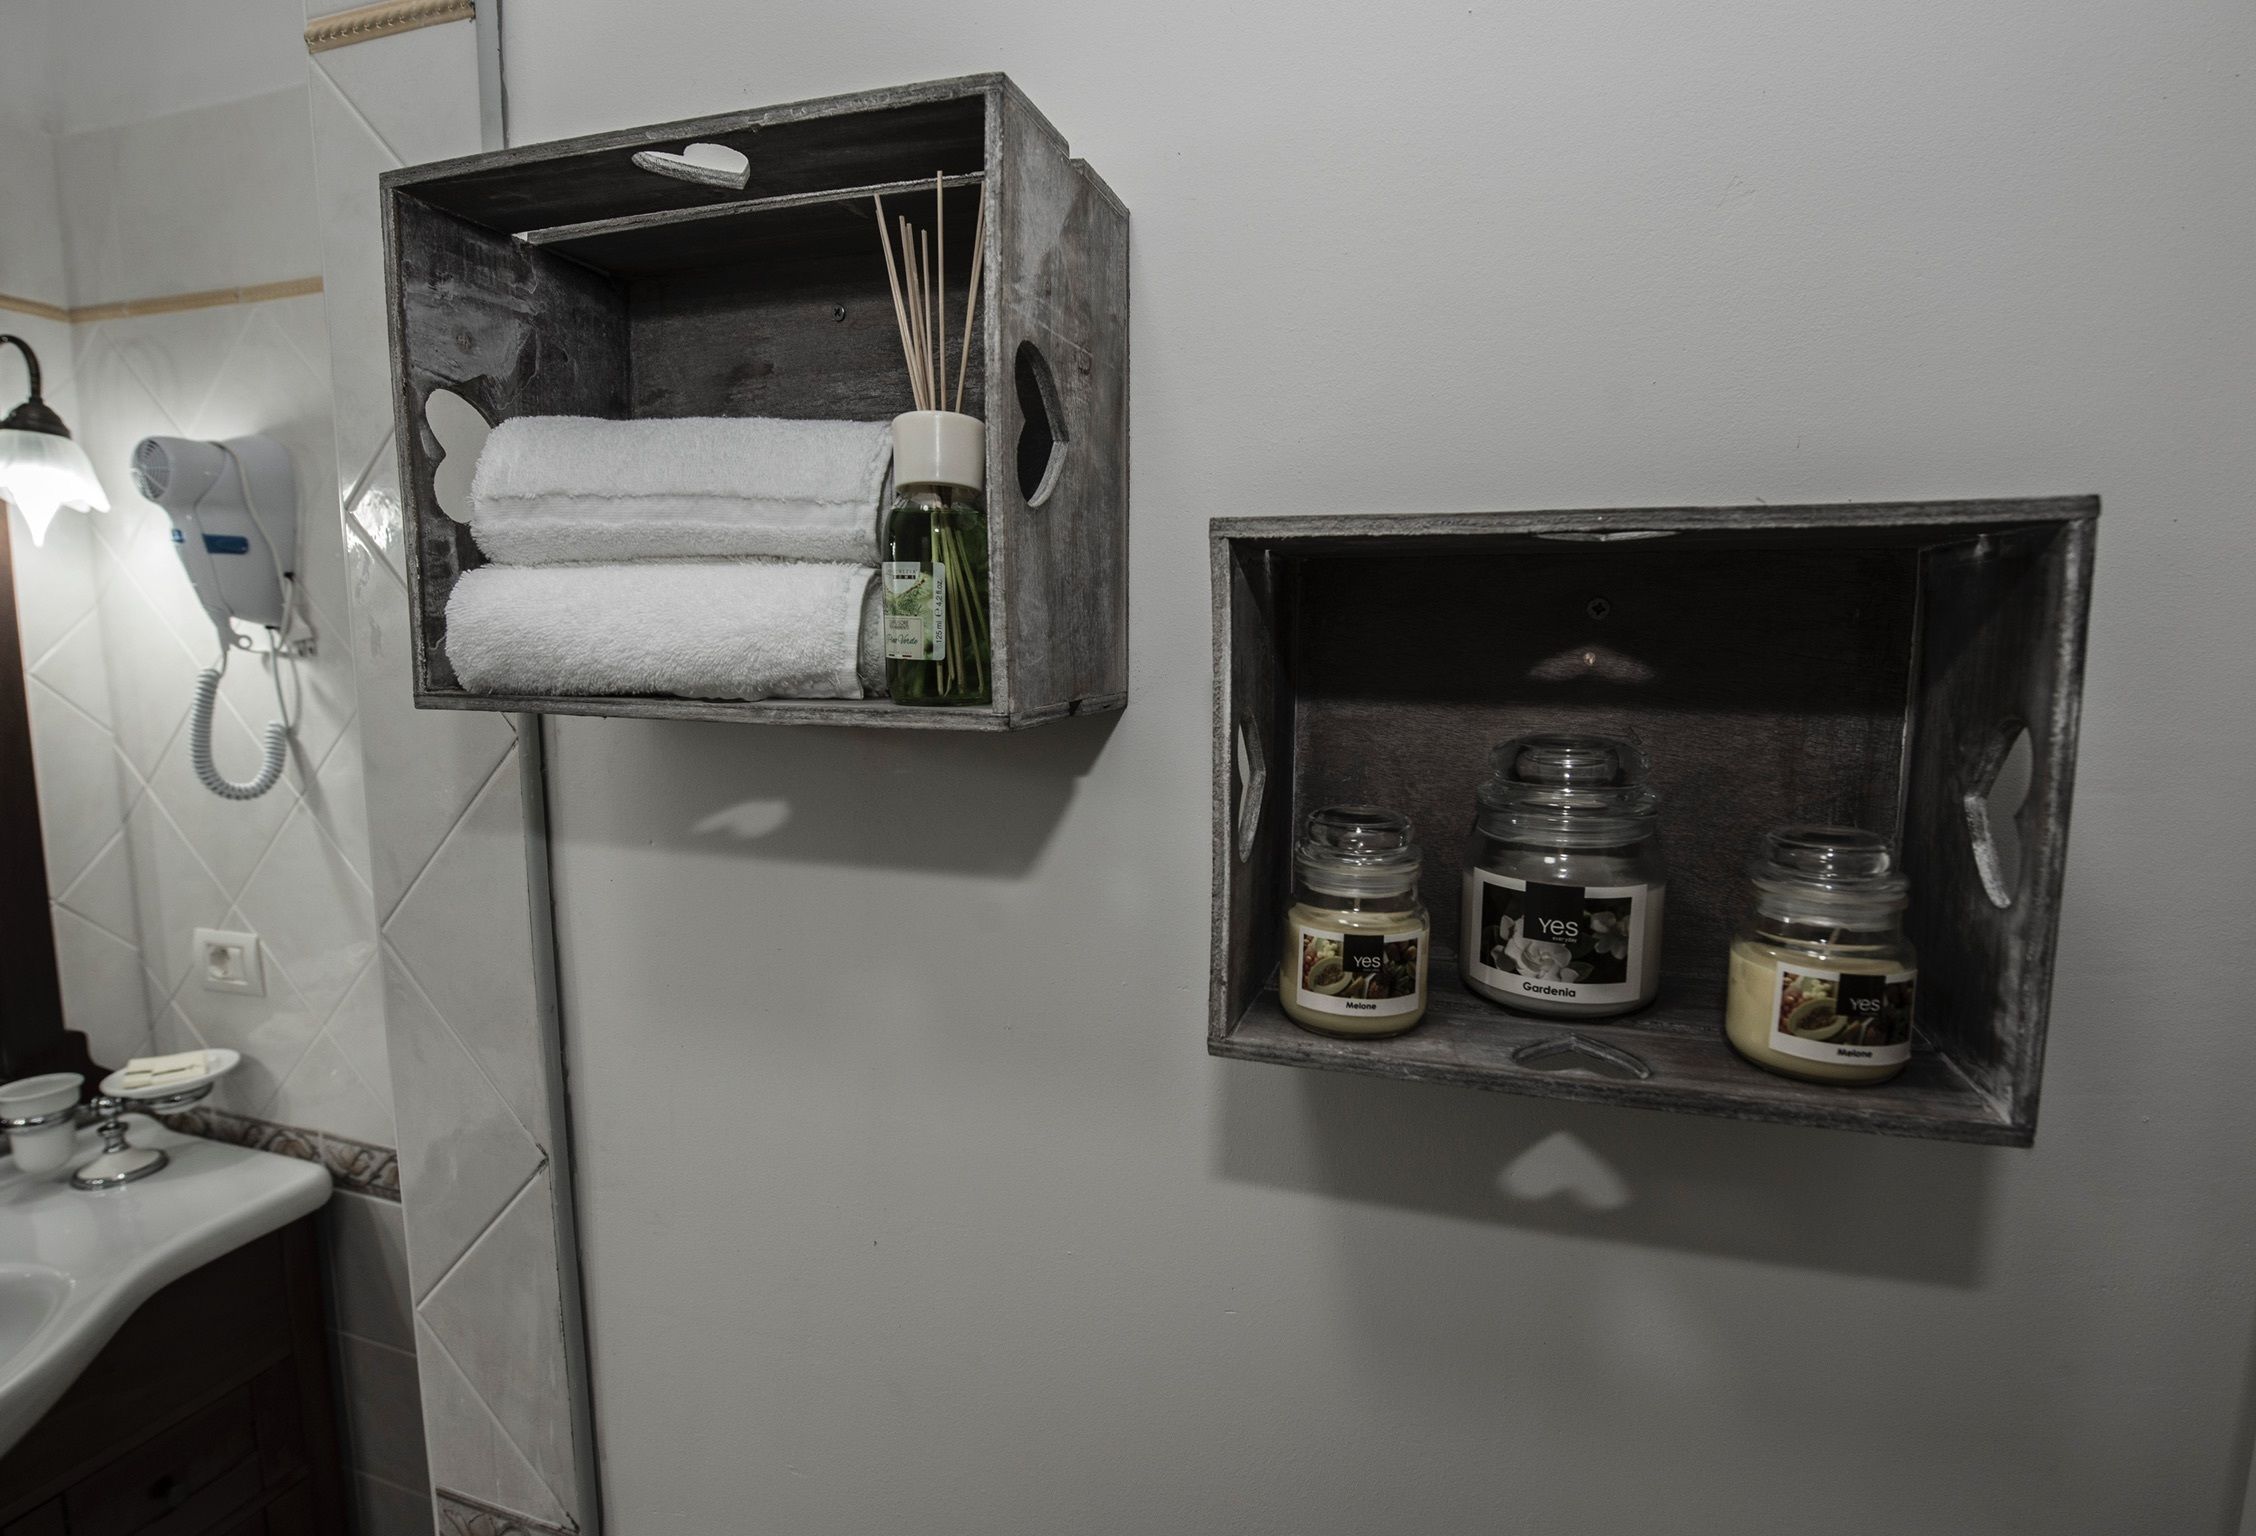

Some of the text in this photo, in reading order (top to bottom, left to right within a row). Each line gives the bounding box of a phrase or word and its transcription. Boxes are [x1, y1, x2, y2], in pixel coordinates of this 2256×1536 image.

[935, 621, 943, 630] ml
[935, 631, 943, 643] 125
[1522, 981, 1576, 998] Gardenia
[1346, 1001, 1377, 1010] Melone
[1837, 1048, 1873, 1059] Melone
